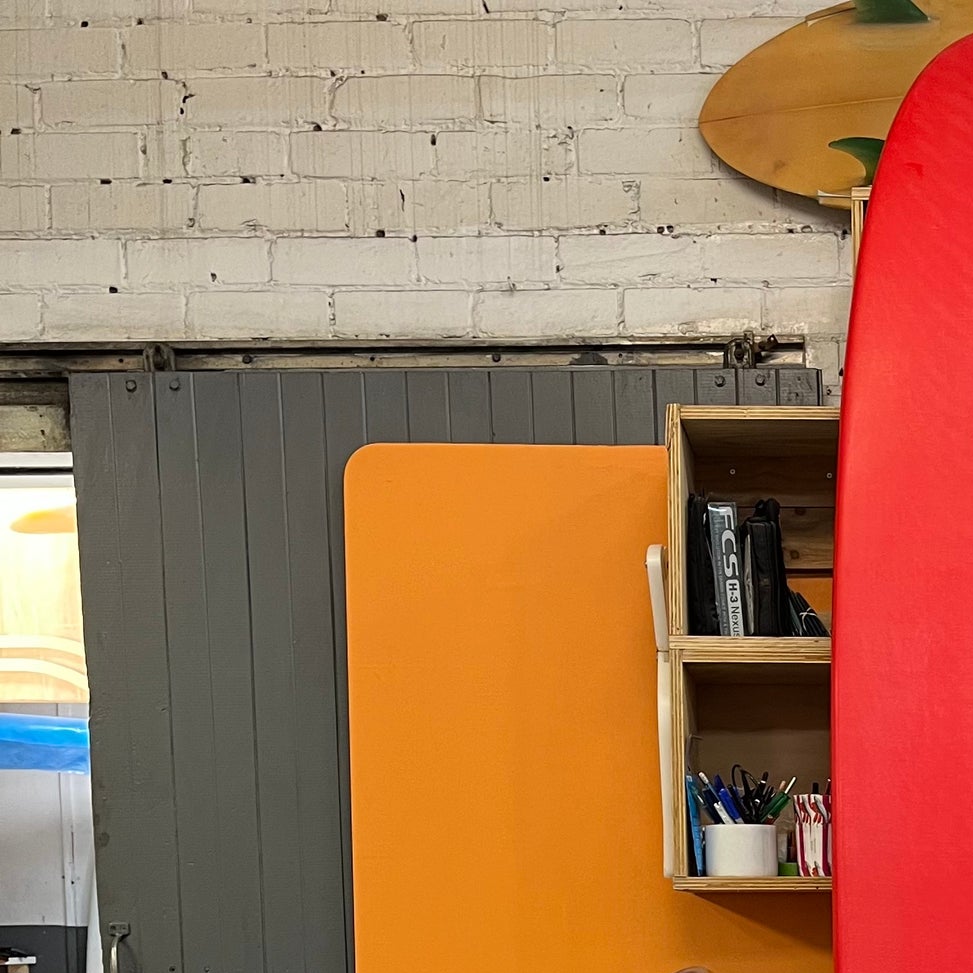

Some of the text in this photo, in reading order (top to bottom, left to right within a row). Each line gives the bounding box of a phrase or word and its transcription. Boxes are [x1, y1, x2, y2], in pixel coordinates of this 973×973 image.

[719, 506, 739, 578] FCS
[729, 583, 739, 603] H-3
[731, 606, 741, 637] Nexus
